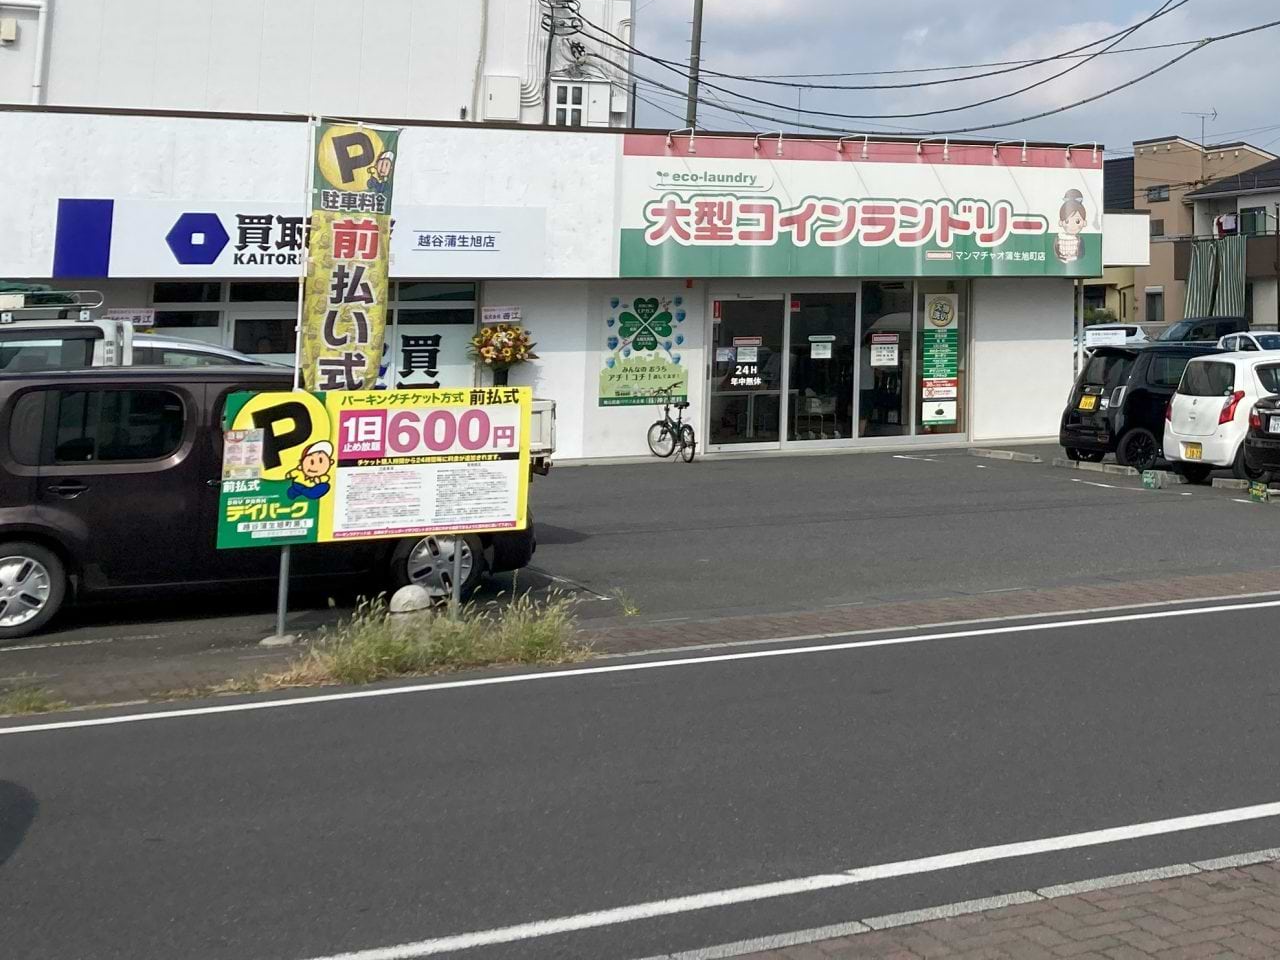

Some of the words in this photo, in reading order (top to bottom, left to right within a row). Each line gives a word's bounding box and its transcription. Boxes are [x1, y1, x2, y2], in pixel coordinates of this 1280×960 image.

[332, 131, 375, 184] P
[672, 171, 757, 185] eco-laundry
[647, 197, 1046, 245] 大型コインランドリー
[417, 234, 496, 248] 越谷蒲生旭店
[955, 251, 1046, 261] マンマチャオ蒲生旭町店
[318, 218, 380, 391] 前払い式
[730, 376, 762, 386] 年中無休
[341, 392, 464, 406] パーキングチケット方式
[469, 389, 520, 406] 前払式
[251, 401, 313, 471] P
[343, 416, 383, 443] 1日
[387, 409, 516, 453] 600円
[223, 480, 260, 493] 前払式
